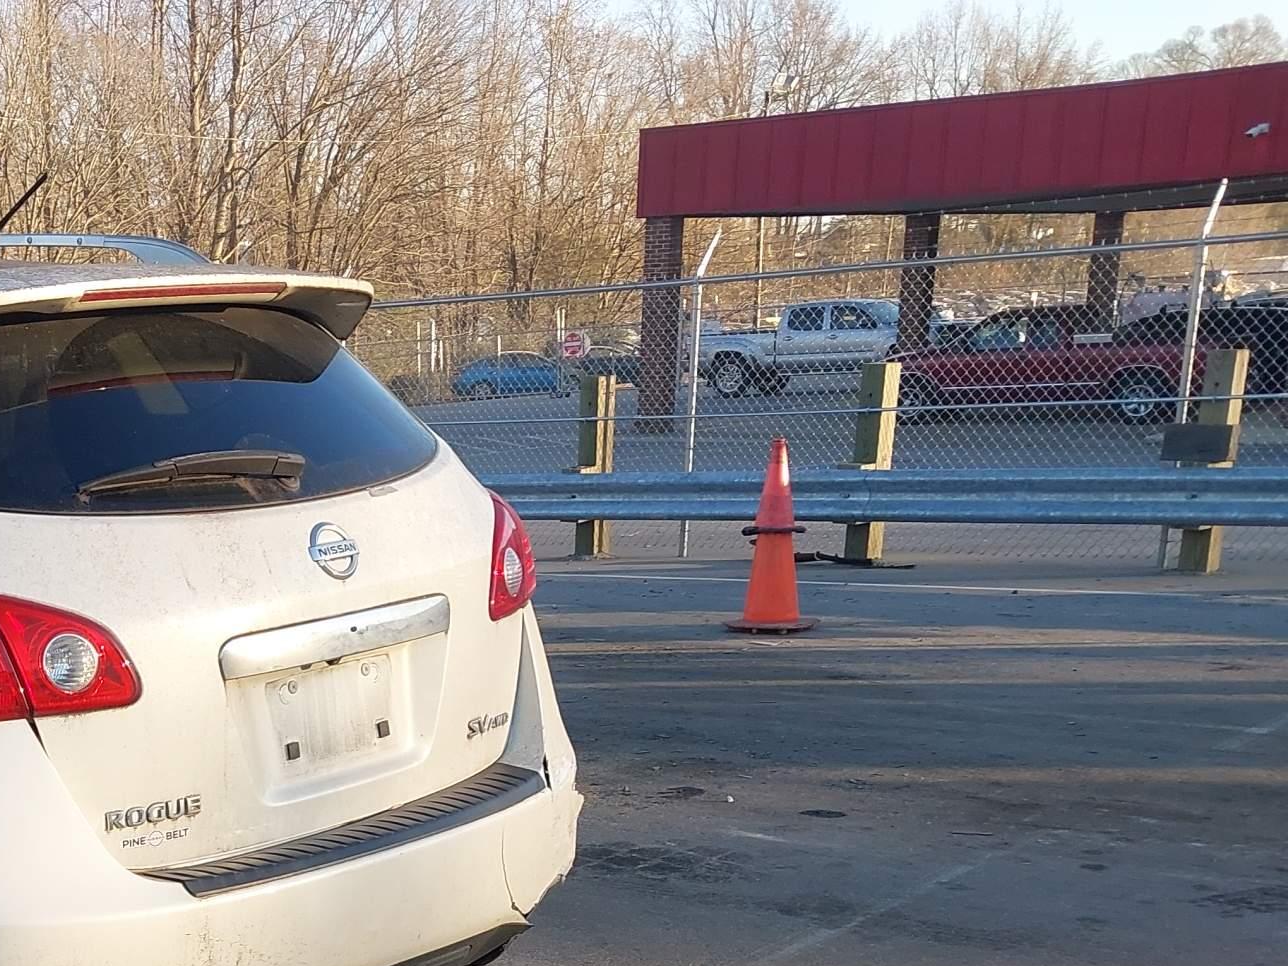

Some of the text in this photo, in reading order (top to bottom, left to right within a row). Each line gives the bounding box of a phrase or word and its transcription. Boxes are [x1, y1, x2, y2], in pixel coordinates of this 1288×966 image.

[318, 543, 357, 557] NISSAN
[104, 794, 201, 832] ROGUE
[122, 837, 146, 849] PINE
[165, 828, 189, 840] BELT
